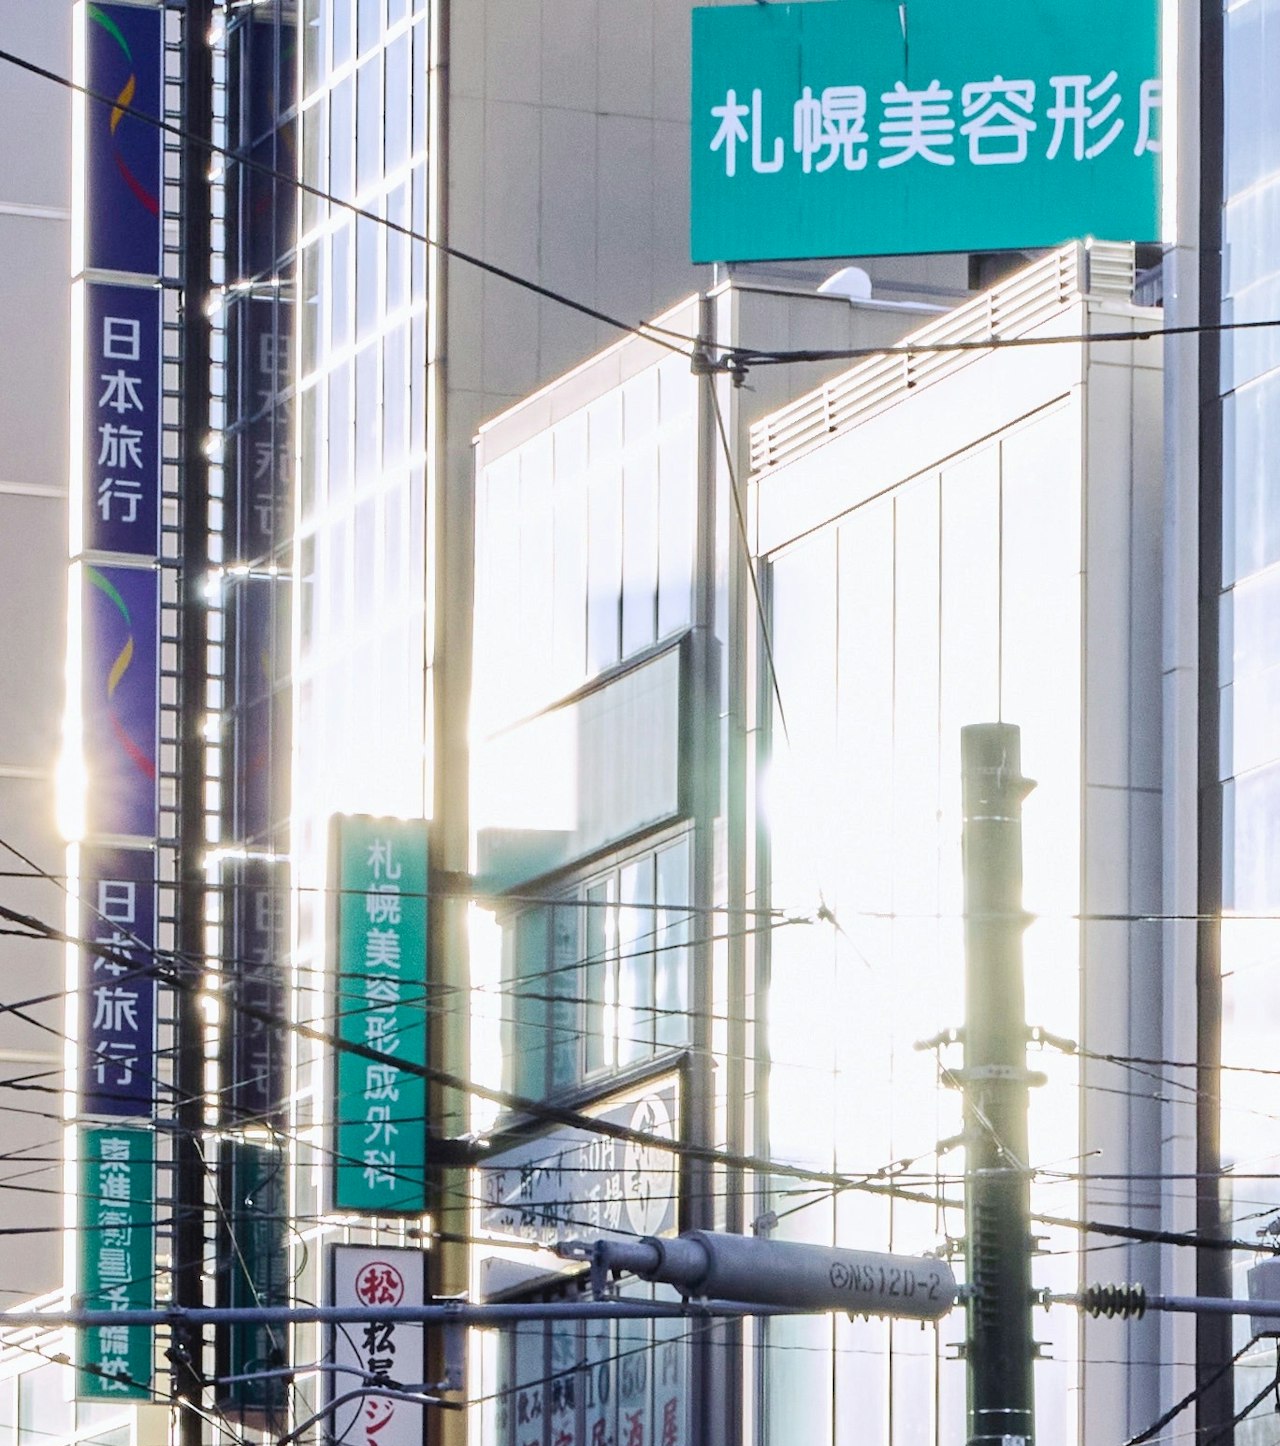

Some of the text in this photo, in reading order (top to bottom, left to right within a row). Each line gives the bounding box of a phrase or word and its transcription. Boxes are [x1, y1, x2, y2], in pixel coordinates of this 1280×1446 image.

[98, 316, 144, 523] 日本旅行
[92, 880, 139, 1086] 日本旅行
[362, 839, 402, 1192] 札幌美容形成外科
